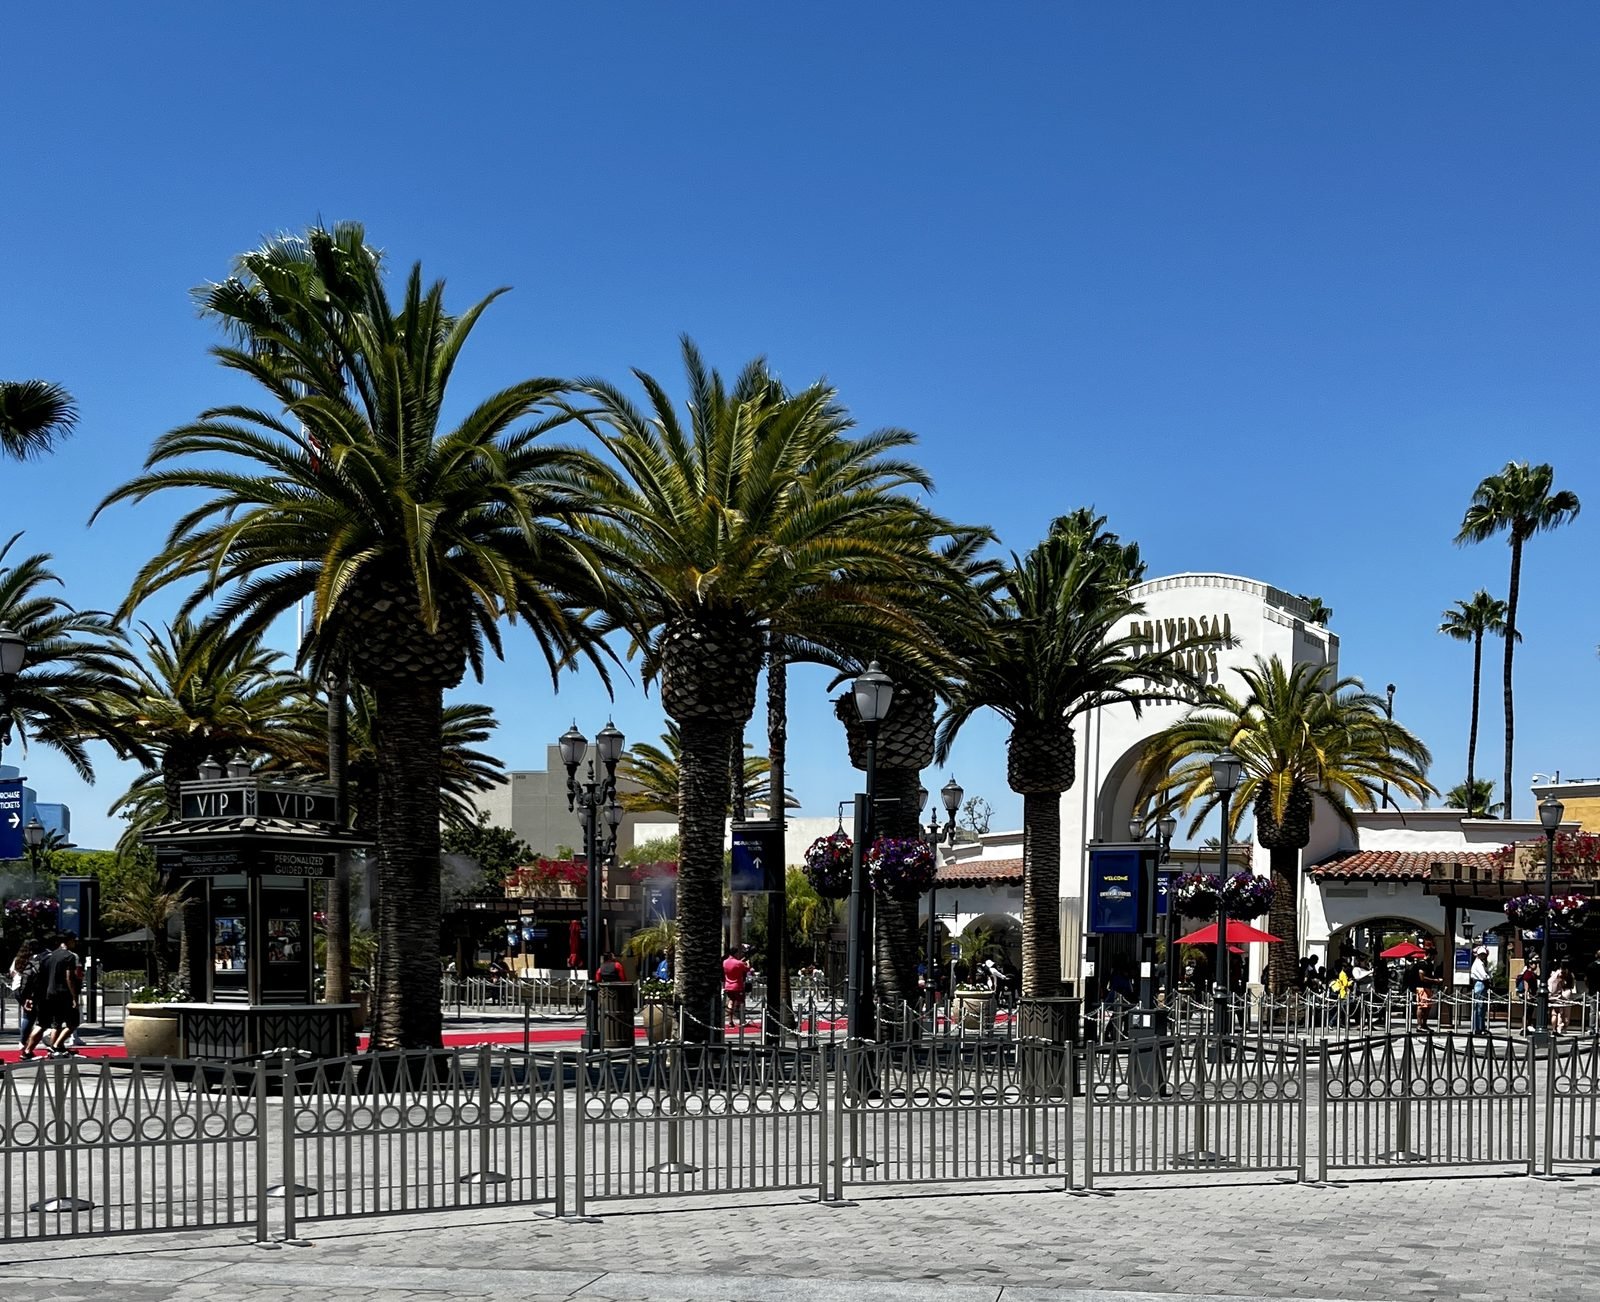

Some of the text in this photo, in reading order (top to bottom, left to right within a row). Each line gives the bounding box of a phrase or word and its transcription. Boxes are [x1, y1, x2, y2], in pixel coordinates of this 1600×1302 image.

[197, 793, 229, 817] VIP
[275, 793, 315, 819] VIP
[274, 854, 324, 866] PERSONALIZED
[274, 866, 324, 876] GUIDED TOUR
